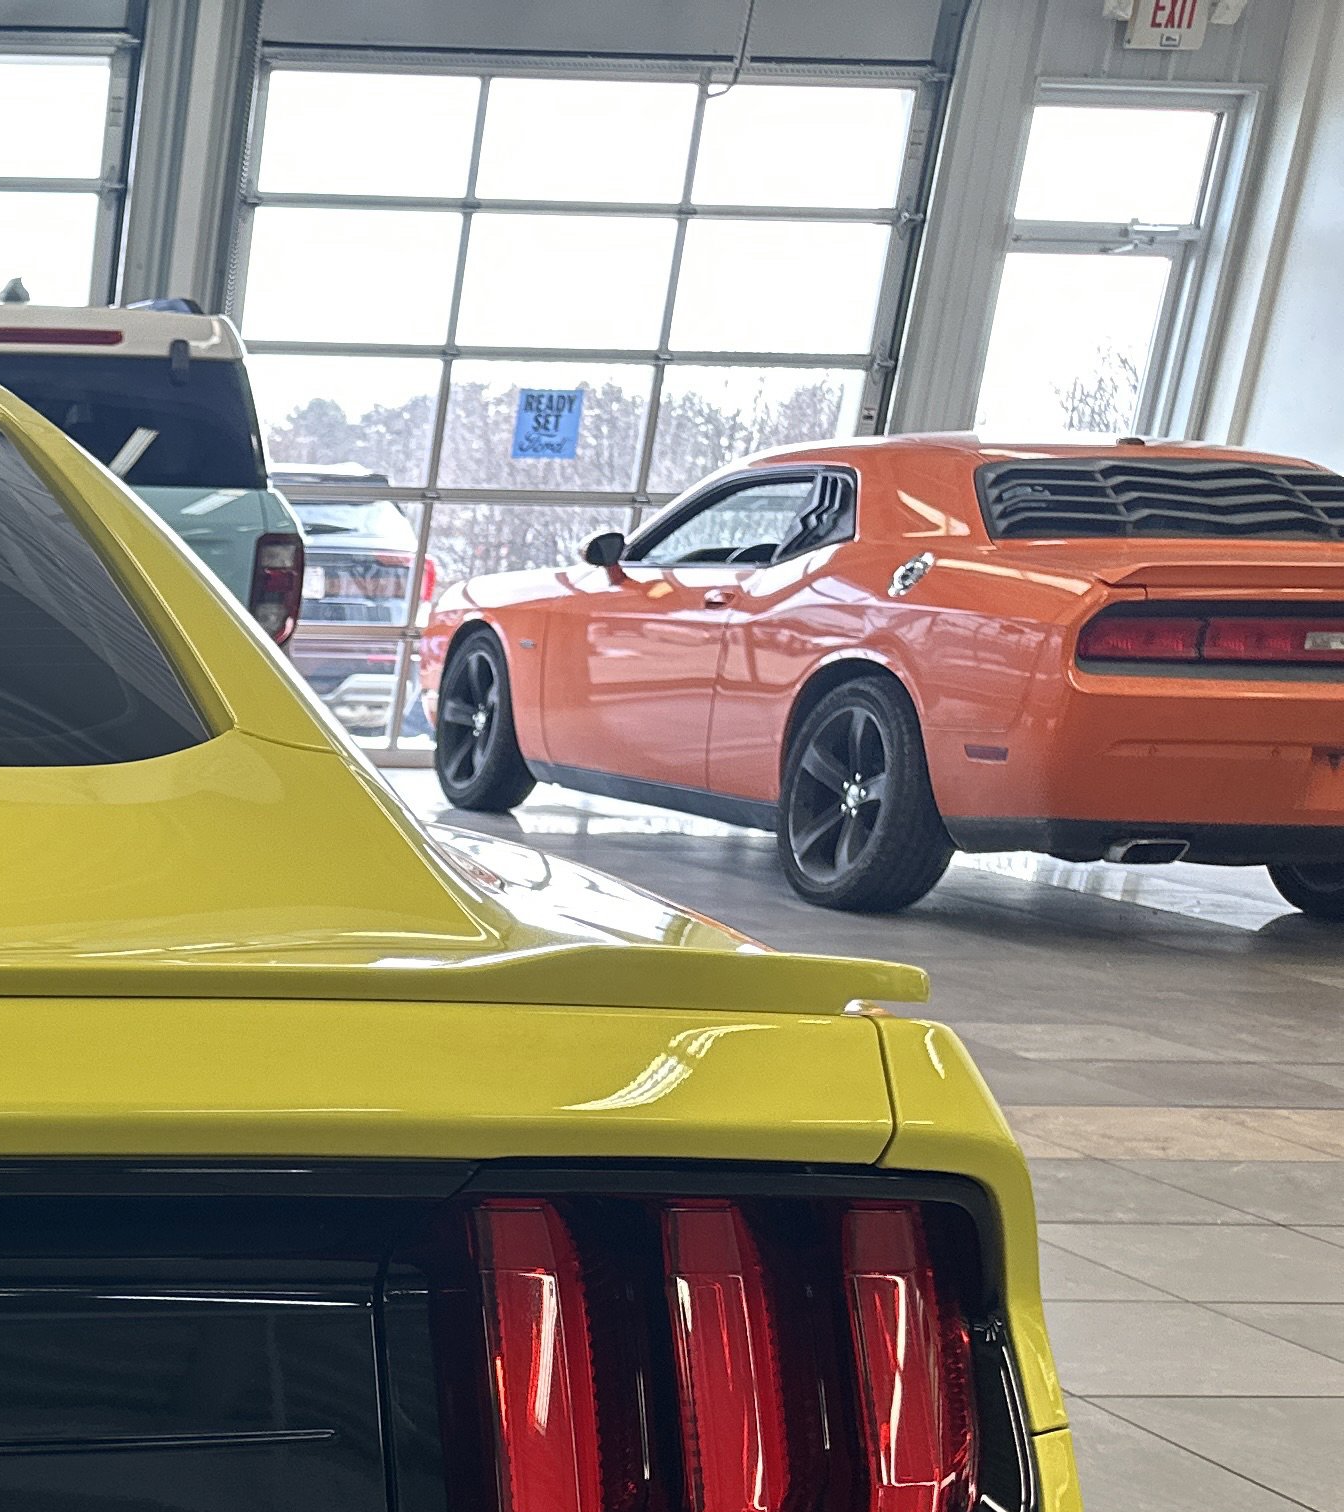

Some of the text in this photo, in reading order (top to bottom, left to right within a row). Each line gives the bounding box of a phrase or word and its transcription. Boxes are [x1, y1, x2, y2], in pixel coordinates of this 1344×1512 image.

[524, 394, 577, 413] READY
[532, 413, 561, 432] SET
[518, 431, 568, 454] Ford
